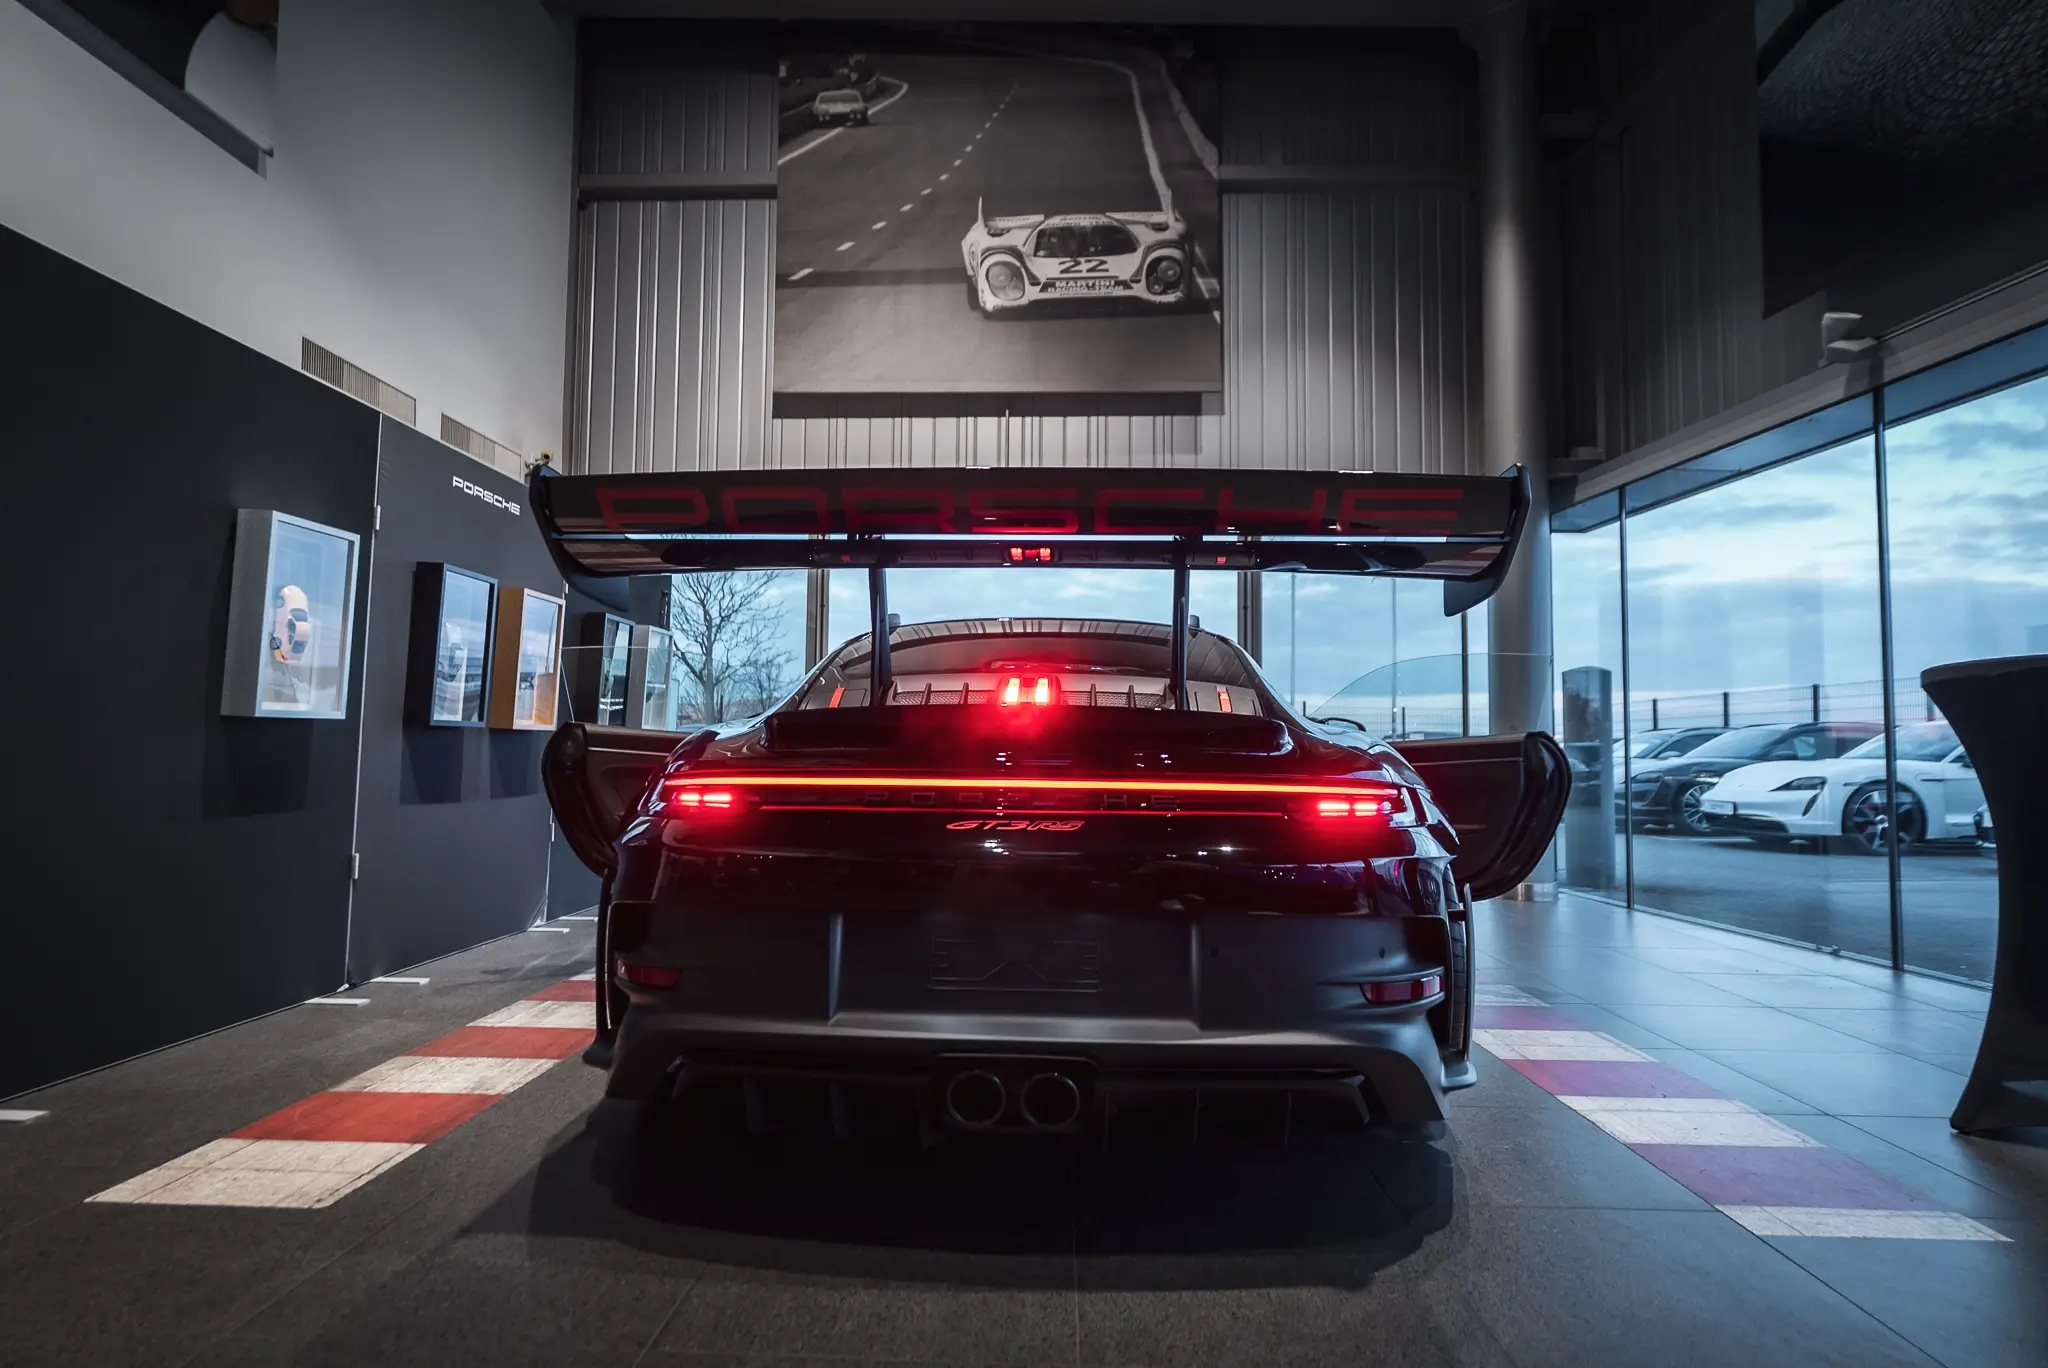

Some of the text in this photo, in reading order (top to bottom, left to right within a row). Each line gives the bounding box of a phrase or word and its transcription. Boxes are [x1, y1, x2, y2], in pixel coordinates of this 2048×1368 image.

[1058, 258, 1110, 275] 22
[1055, 279, 1115, 287] MARTINI
[452, 475, 521, 516] PORSCHE
[596, 487, 1464, 535] PORSCHE
